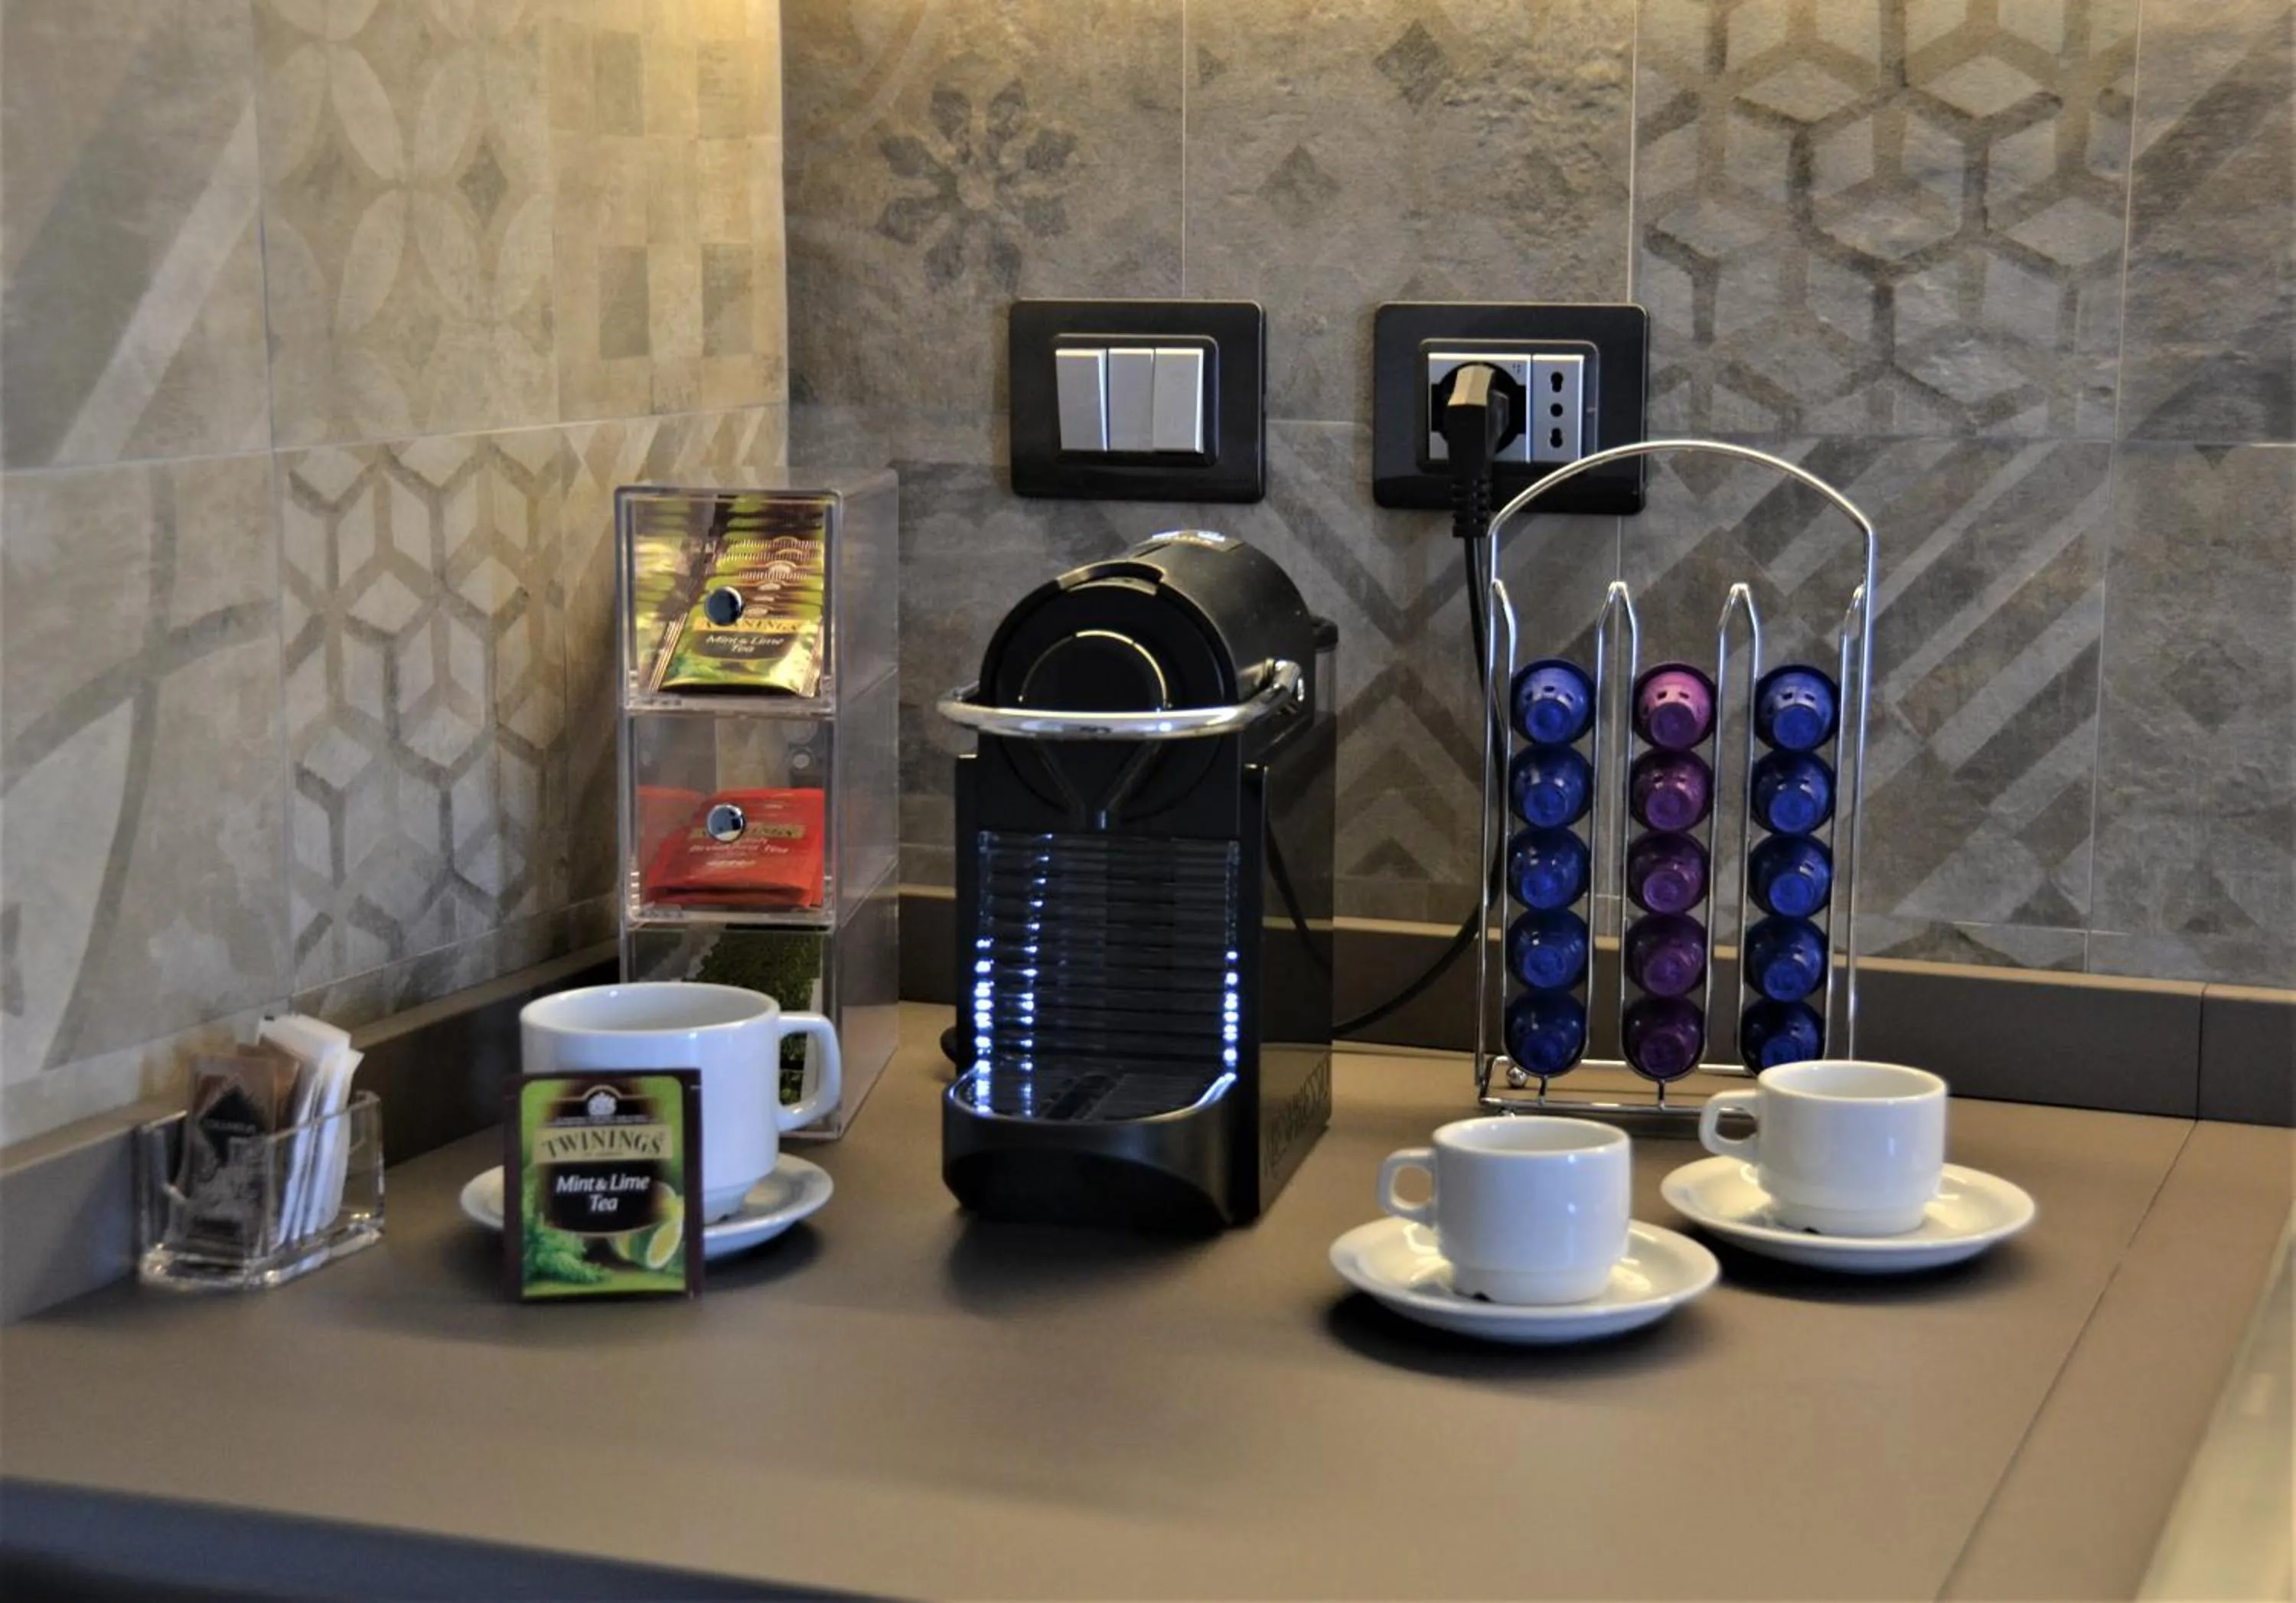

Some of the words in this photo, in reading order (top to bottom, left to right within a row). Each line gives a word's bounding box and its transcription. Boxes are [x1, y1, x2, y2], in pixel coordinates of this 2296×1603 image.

[540, 1129, 662, 1159] TWININGS
[556, 1175, 595, 1193] Mint
[609, 1173, 652, 1191] Lime
[589, 1193, 619, 1212] Tea
